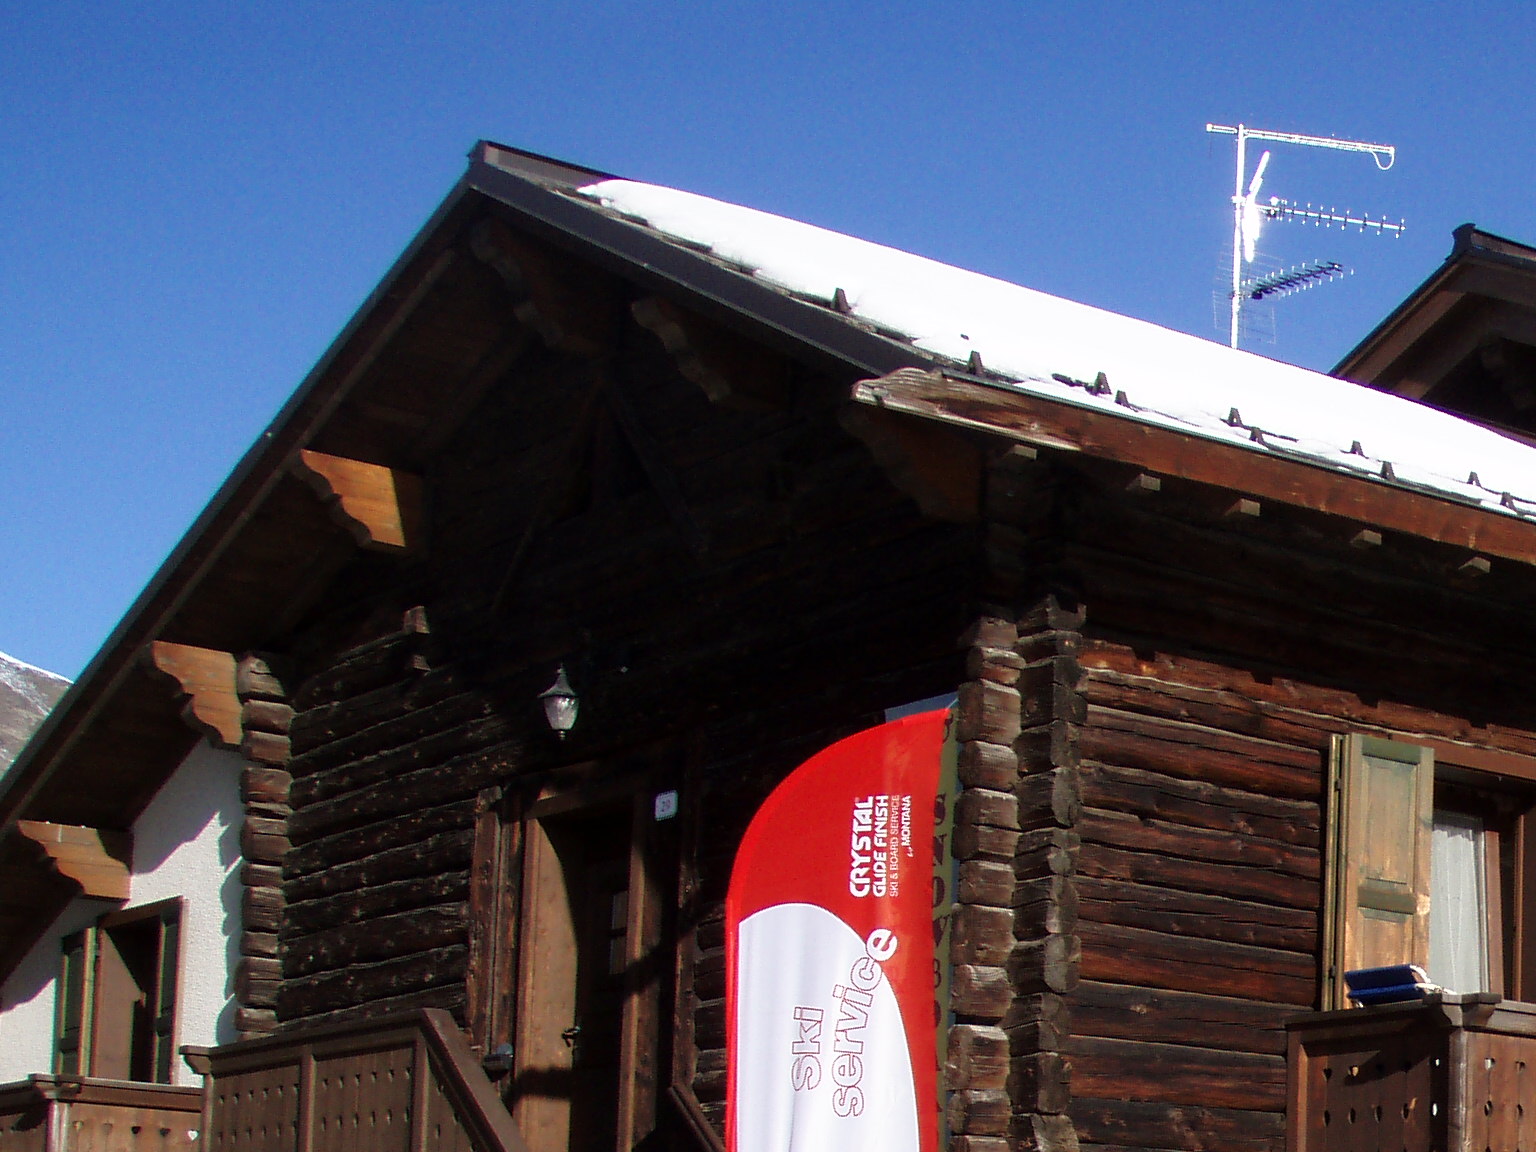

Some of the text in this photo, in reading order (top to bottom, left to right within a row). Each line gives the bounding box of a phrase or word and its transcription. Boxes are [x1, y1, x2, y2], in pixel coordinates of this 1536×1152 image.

[891, 795, 900, 835] SERVICE
[901, 795, 911, 846] MONTANA
[850, 795, 874, 898] CRYSTAL
[873, 795, 889, 897] GLIDE FINISH
[890, 837, 899, 871] BOARD
[890, 881, 899, 897] SKI
[832, 927, 898, 1118] service
